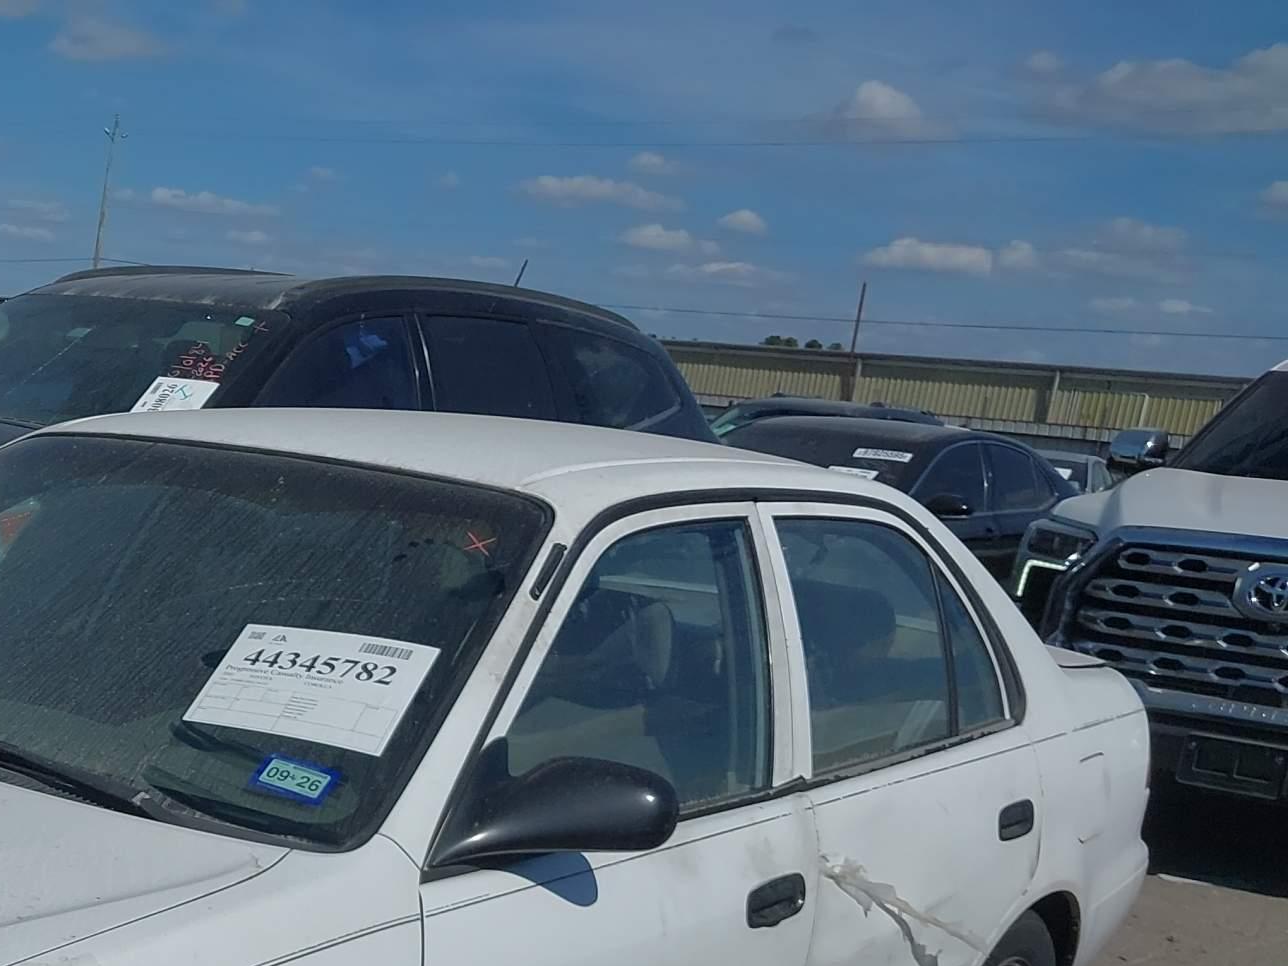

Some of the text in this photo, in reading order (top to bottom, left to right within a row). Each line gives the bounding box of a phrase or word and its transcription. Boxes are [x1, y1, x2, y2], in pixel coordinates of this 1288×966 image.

[243, 648, 398, 686] 44345782
[266, 766, 291, 782] 09
[295, 775, 322, 792] 26
